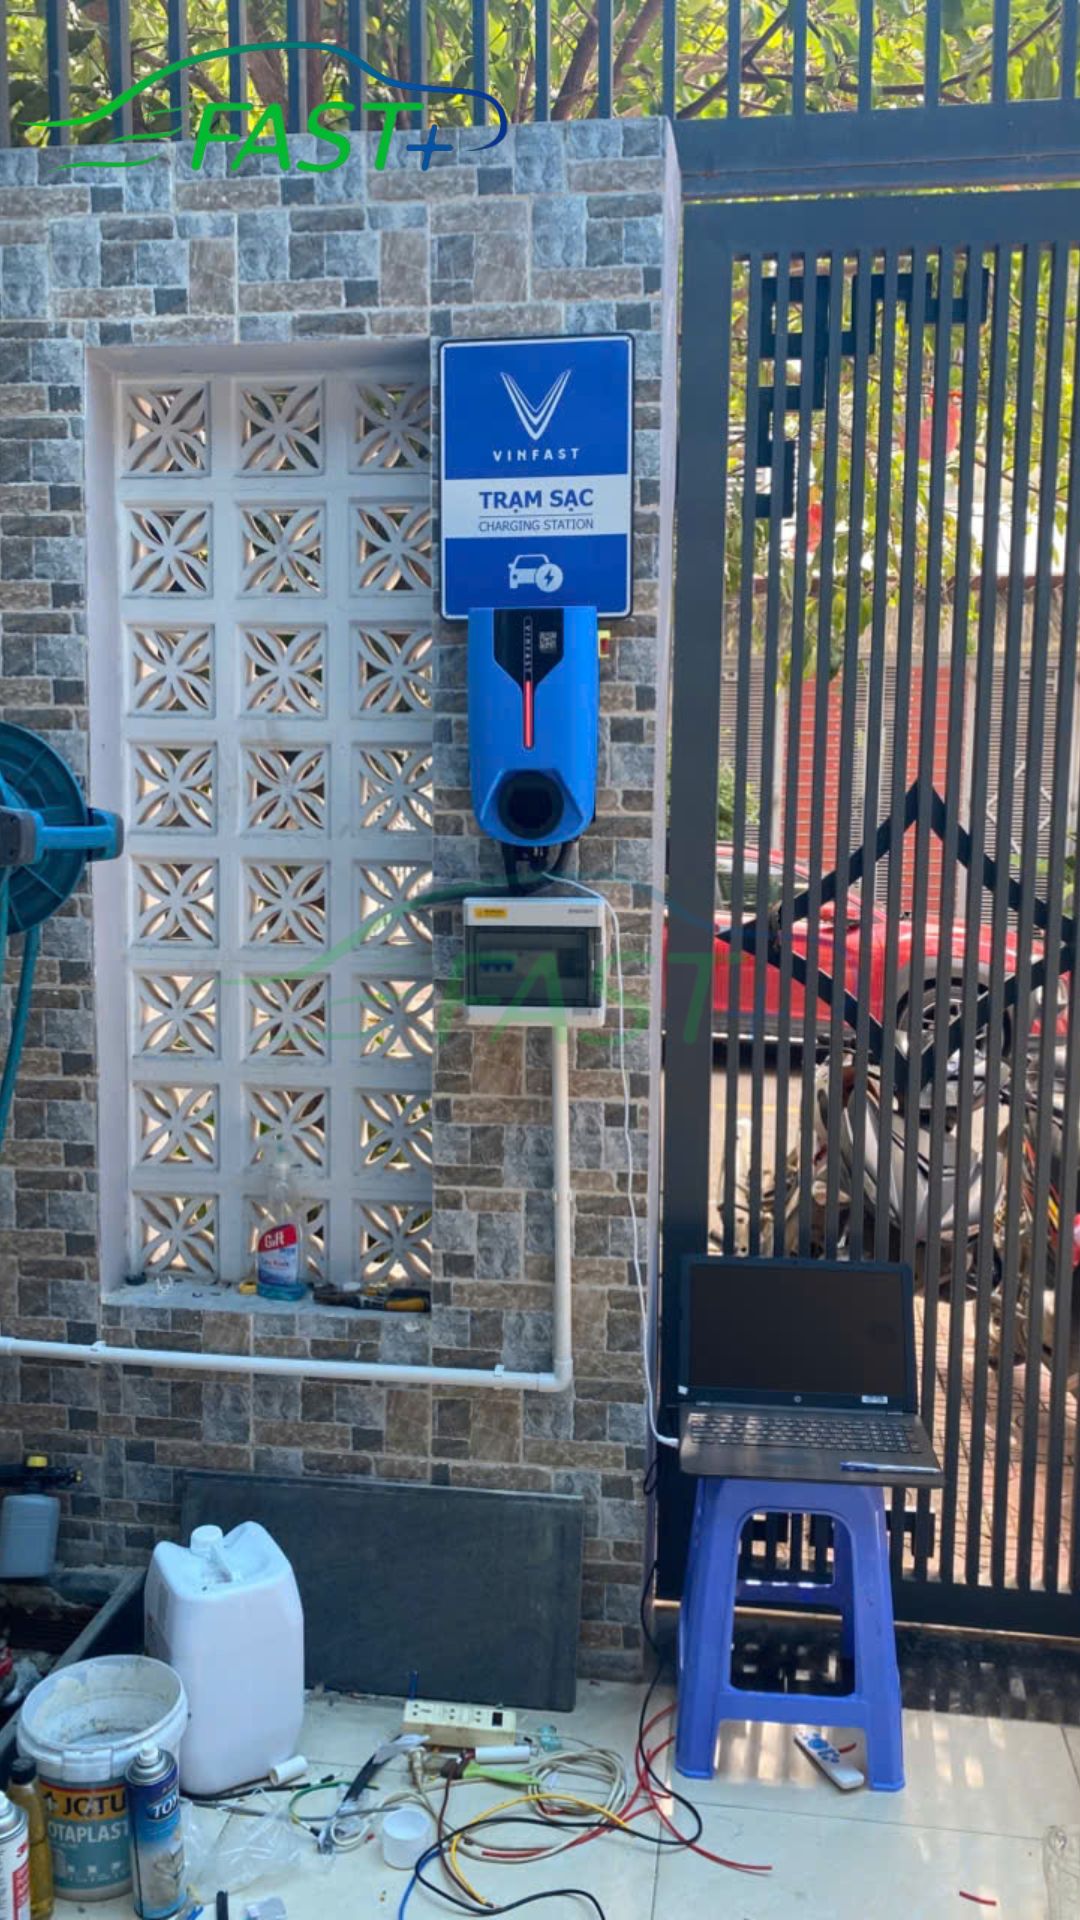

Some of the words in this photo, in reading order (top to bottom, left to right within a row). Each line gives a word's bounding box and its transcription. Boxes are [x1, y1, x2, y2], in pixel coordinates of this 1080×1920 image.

[493, 449, 579, 462] VINFAST
[478, 490, 543, 514] TRẠM
[549, 488, 594, 512] SẠC
[478, 520, 541, 532] CHARGING
[542, 518, 594, 531] STATION
[63, 1795, 126, 1816] JOTU
[51, 1823, 129, 1843] OTAPLAST
